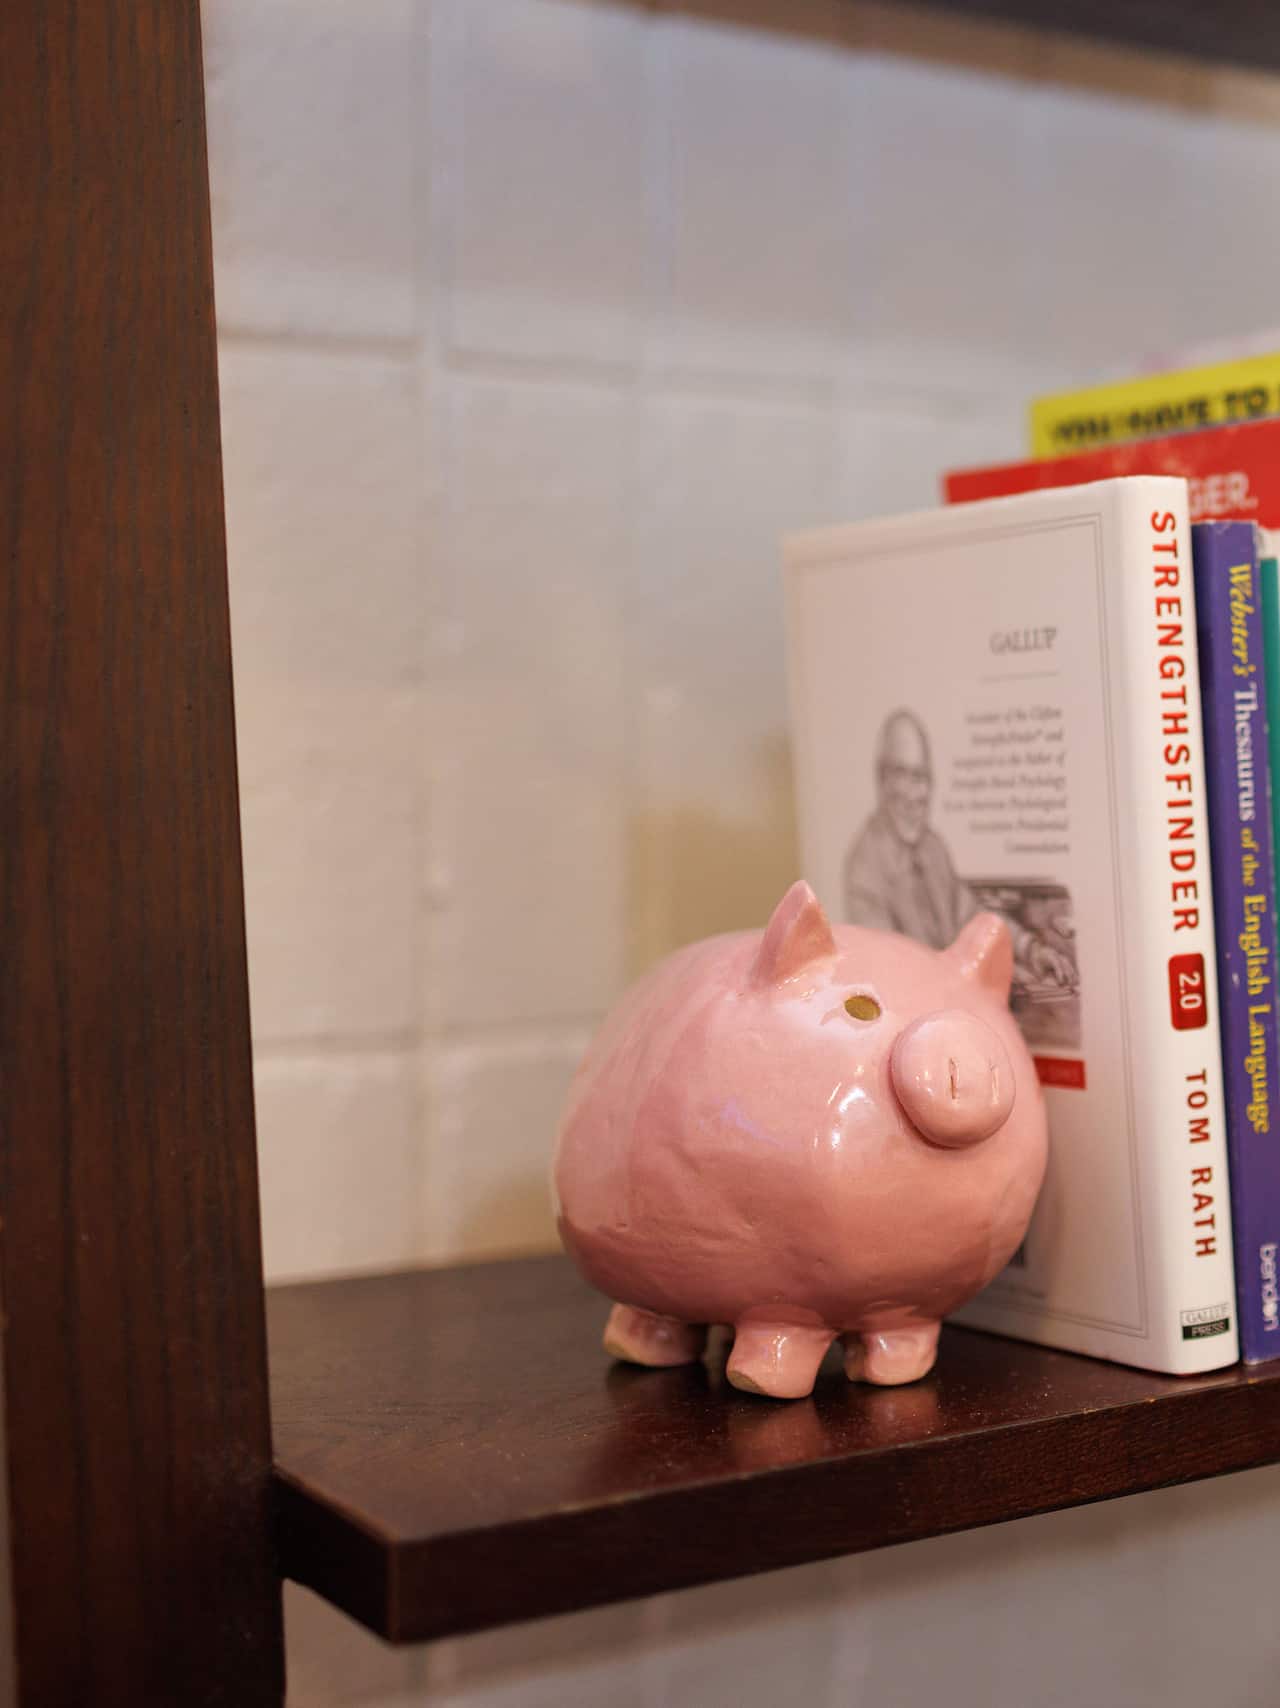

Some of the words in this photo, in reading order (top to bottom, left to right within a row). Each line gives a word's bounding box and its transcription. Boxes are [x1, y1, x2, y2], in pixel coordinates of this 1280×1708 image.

[1224, 386, 1269, 415] TO
[1228, 563, 1257, 678] Webster's
[1151, 511, 1200, 932] STRENGTHSFINDER
[1178, 971, 1203, 1010] 2.0
[1233, 681, 1259, 822] Thesaurus
[1240, 827, 1260, 852] of
[1241, 854, 1261, 887] the
[1239, 893, 1271, 996] English
[1186, 1068, 1211, 1144] TOM
[1243, 1003, 1272, 1135] Language
[1191, 1166, 1217, 1258] RATH
[1191, 1322, 1226, 1338] PRESS
[1258, 1242, 1280, 1332] bendon
